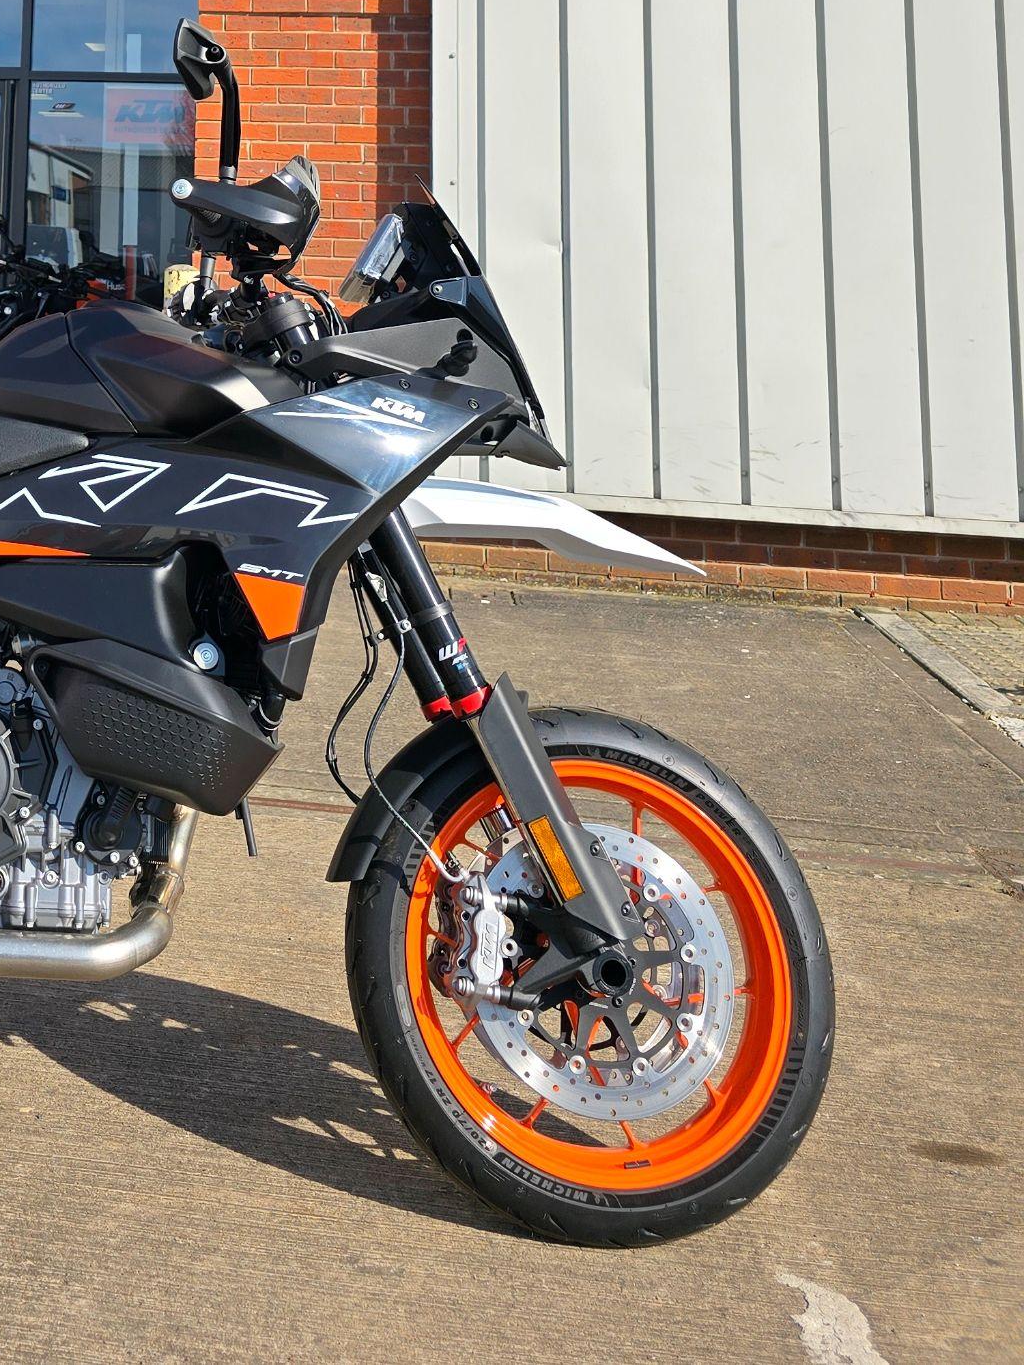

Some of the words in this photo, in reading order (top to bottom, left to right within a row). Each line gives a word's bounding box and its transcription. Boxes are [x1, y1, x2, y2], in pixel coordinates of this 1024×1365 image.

[371, 397, 426, 424] KTM
[237, 563, 305, 580] SMT
[438, 637, 468, 662] WP
[605, 749, 690, 791] MICHELIN
[696, 792, 742, 836] POWER
[500, 1156, 589, 1204] MICHELIN
